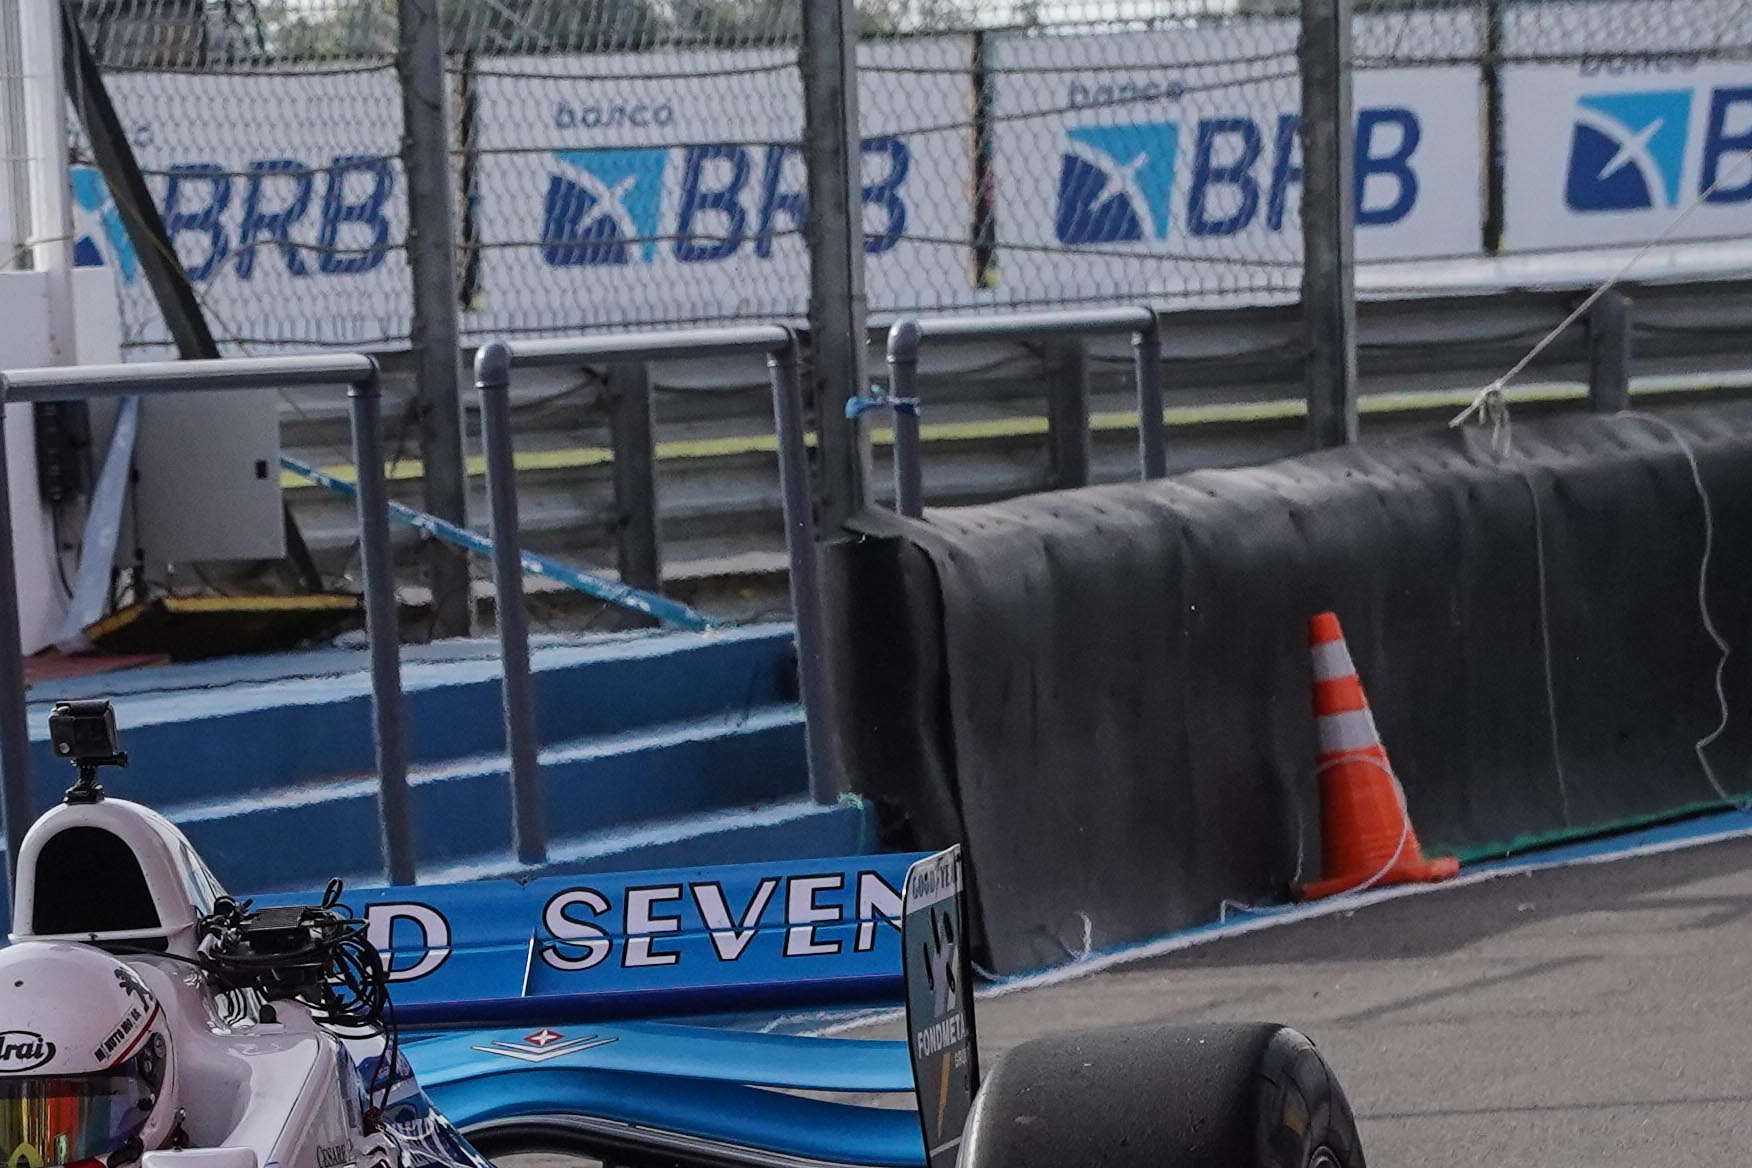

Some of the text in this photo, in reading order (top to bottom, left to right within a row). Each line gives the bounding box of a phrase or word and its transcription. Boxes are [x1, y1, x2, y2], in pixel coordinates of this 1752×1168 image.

[553, 101, 674, 129] banco
[160, 155, 396, 282] BRB
[326, 869, 904, 984] D SEVEN
